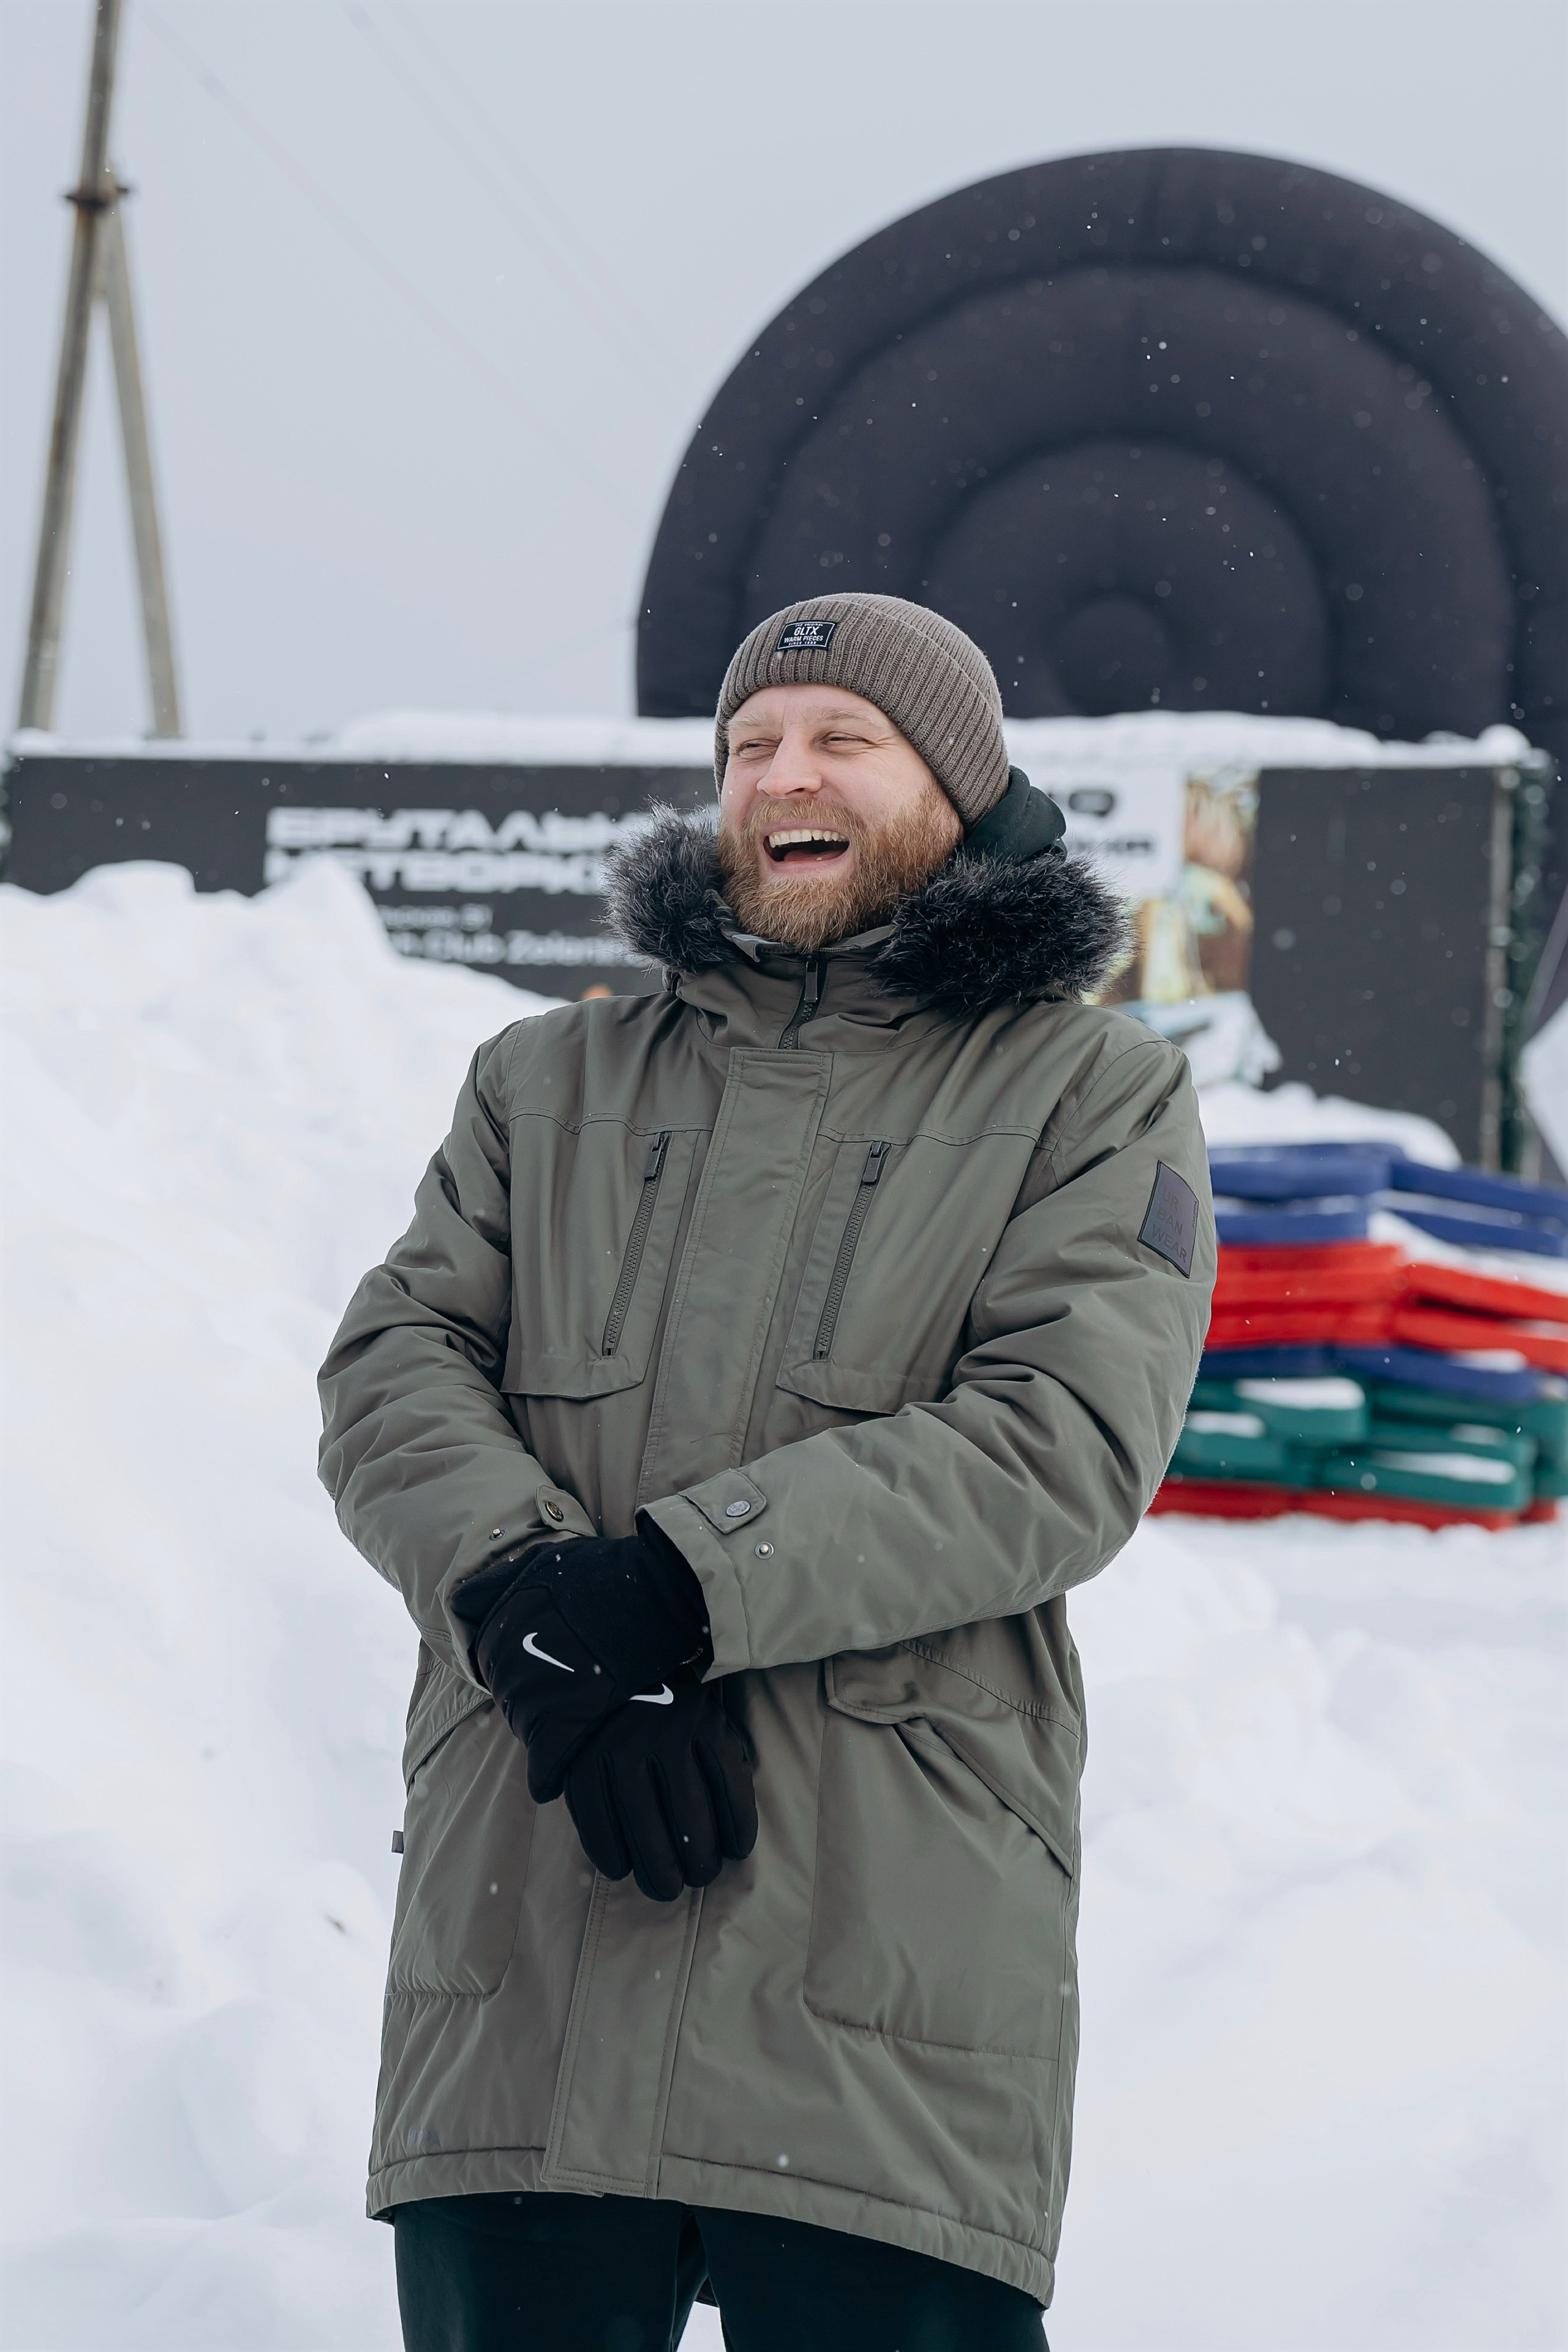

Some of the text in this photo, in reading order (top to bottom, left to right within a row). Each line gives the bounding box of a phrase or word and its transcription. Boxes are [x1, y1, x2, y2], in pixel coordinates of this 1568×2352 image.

[794, 626, 820, 636] GLTX
[1157, 1209, 1183, 1236] BAN
[1152, 1224, 1187, 1264] WEAR
